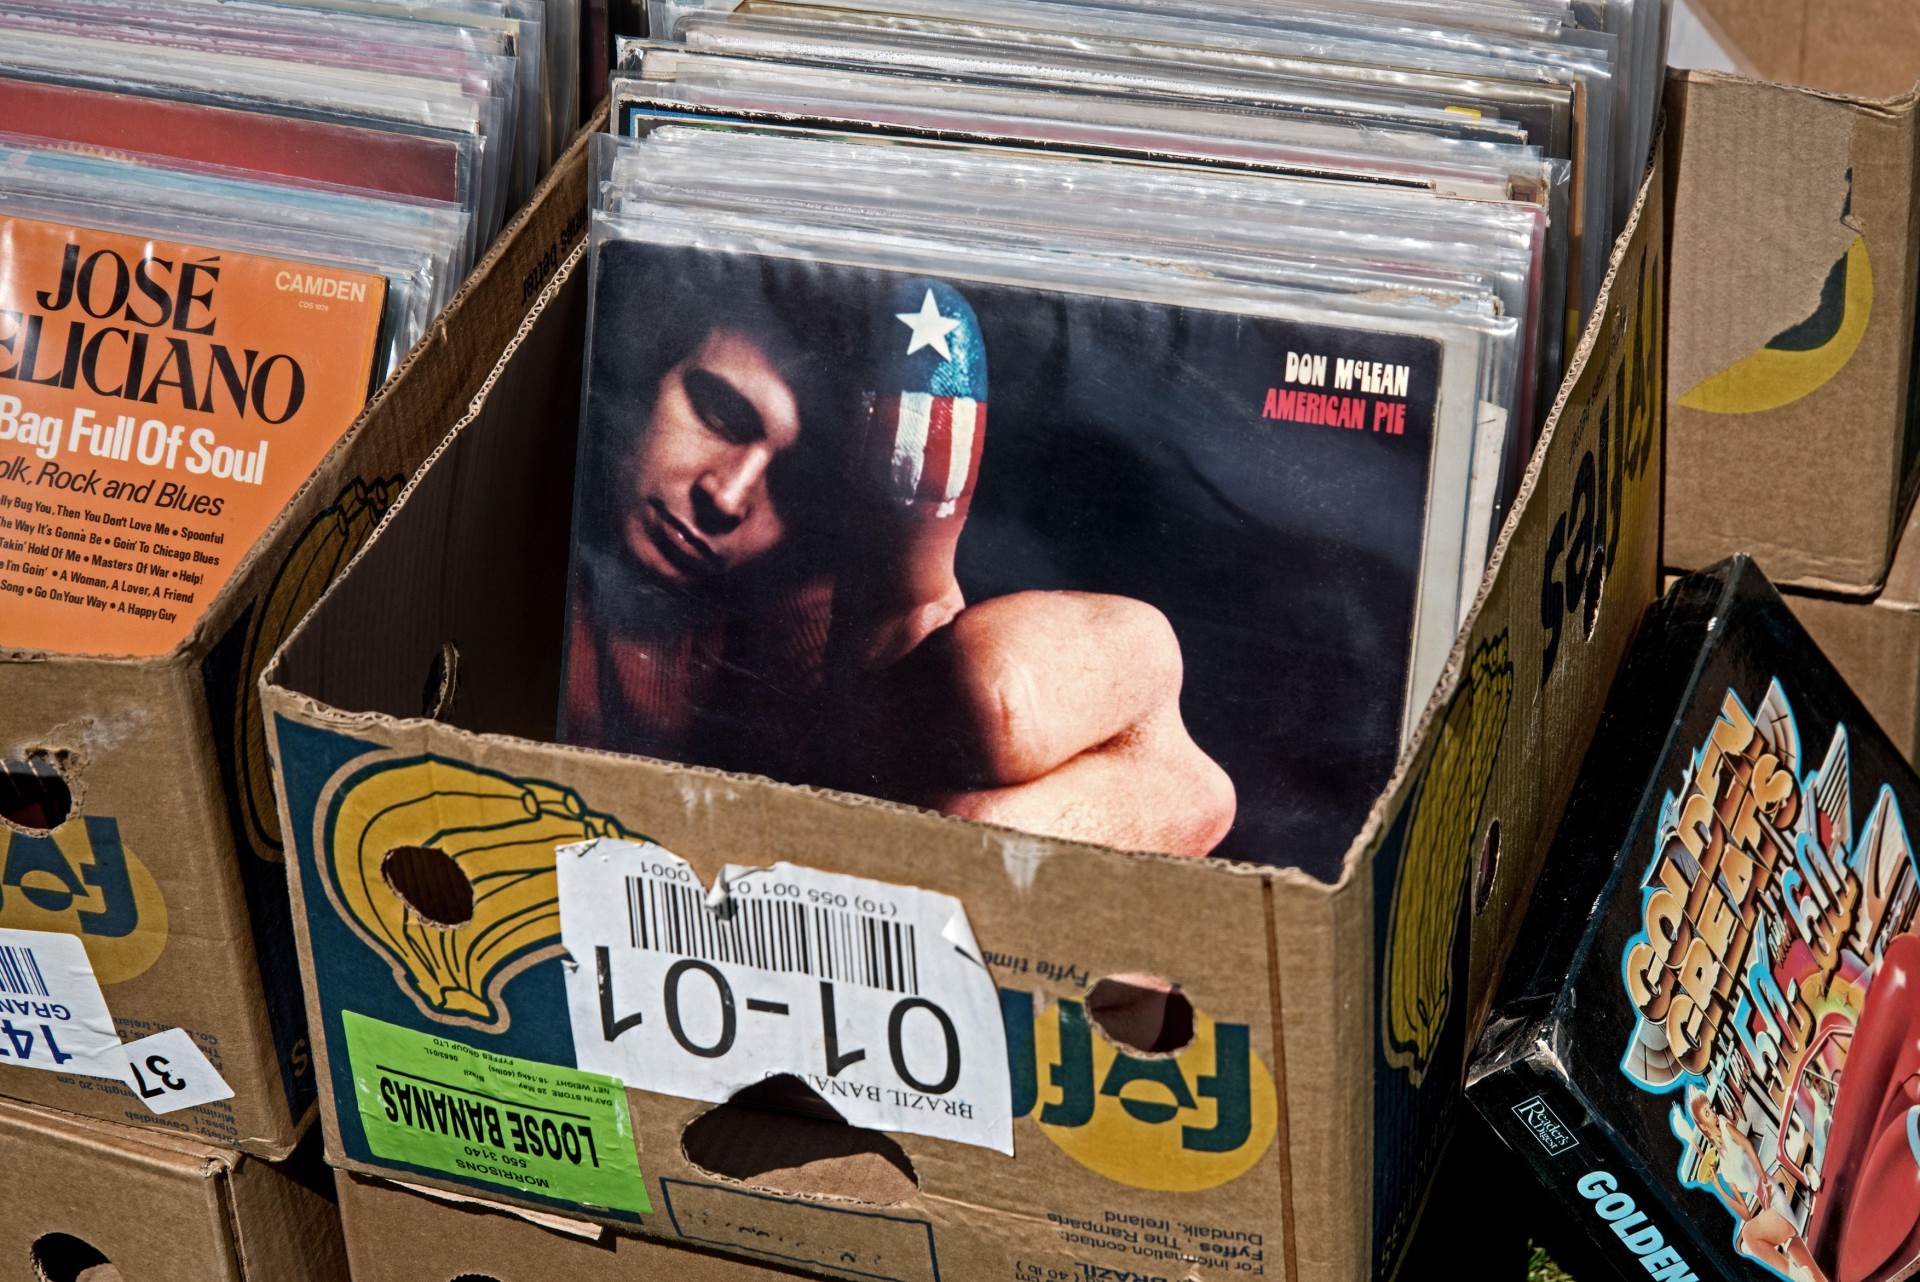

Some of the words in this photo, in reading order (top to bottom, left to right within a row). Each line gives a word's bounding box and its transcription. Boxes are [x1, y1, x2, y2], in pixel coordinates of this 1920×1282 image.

[36, 244, 220, 336] JOSÉ
[275, 271, 367, 303] CAMDEN
[1284, 351, 1327, 387] DON
[1262, 388, 1366, 430] AMERICAN
[1373, 402, 1407, 435] PIE
[0, 394, 63, 460] Bag
[68, 407, 136, 462] Full
[136, 419, 186, 470] Of
[185, 427, 269, 486] Soul
[36, 462, 101, 496] Rock
[103, 479, 156, 504] and
[155, 482, 225, 517] Blues
[14, 497, 33, 513] Bug
[57, 504, 80, 520] Then
[84, 509, 101, 524] You
[103, 513, 127, 528] Don't
[129, 517, 152, 532] Love
[154, 522, 170, 536] Me
[180, 527, 225, 545] Spoonful
[0, 515, 12, 529] he
[15, 519, 35, 536] Way
[37, 523, 52, 536] It's
[55, 527, 86, 542] Gonna
[89, 533, 102, 545] Be
[113, 537, 138, 551] Goin'
[139, 541, 150, 553] To
[153, 544, 191, 562] Chicago
[193, 551, 220, 566] Blues
[28, 542, 50, 557] Hold
[51, 547, 63, 559] Of
[65, 549, 81, 562] Me
[92, 554, 133, 572] Masters
[136, 561, 148, 574] Of
[150, 564, 170, 578] War
[179, 570, 204, 586] Help!
[6, 559, 20, 572] I'm
[59, 569, 67, 581] A
[71, 571, 109, 589] Woman,
[111, 580, 119, 591] A
[121, 580, 151, 597] Lover,
[152, 586, 160, 598] A
[163, 588, 195, 604] Friend
[0, 579, 25, 597] Song
[34, 586, 47, 598] Go
[49, 588, 62, 601] On
[63, 591, 84, 605] Your
[86, 595, 107, 612] Way
[117, 601, 125, 613] A
[127, 602, 158, 621] Happy
[159, 608, 177, 624] Guy
[1626, 688, 1756, 1016] GOLDEN
[762, 881, 801, 899] 001
[807, 887, 848, 907] 055
[1667, 753, 1795, 1066] GREATS
[1036, 961, 1089, 989] Fyffe
[594, 945, 962, 1096] 01-01
[0, 1019, 73, 1065] 14
[433, 1038, 449, 1048] LTD
[451, 1044, 480, 1058] GROUP
[482, 1053, 514, 1066] FYFFES
[130, 1055, 187, 1100] 37
[555, 1080, 591, 1091] WEIGHT
[551, 1090, 582, 1102] STORE
[886, 1089, 973, 1120] BRAZIL
[125, 1112, 190, 1132] Cavendish
[380, 1076, 506, 1150] BANANAS
[1518, 1100, 1569, 1146] Reader's
[506, 1111, 600, 1169] LOOSE
[1533, 1123, 1558, 1149] Digest
[463, 1145, 497, 1161] 3140
[502, 1154, 527, 1169] 550
[455, 1158, 550, 1189] MORRISONS
[1046, 1212, 1138, 1244] Ramparts
[1104, 1211, 1170, 1233] Ireland
[1577, 1171, 1700, 1282] GOLDEN
[1144, 1233, 1181, 1250] The
[1132, 1245, 1229, 1272] information
[1235, 1262, 1264, 1276] For
